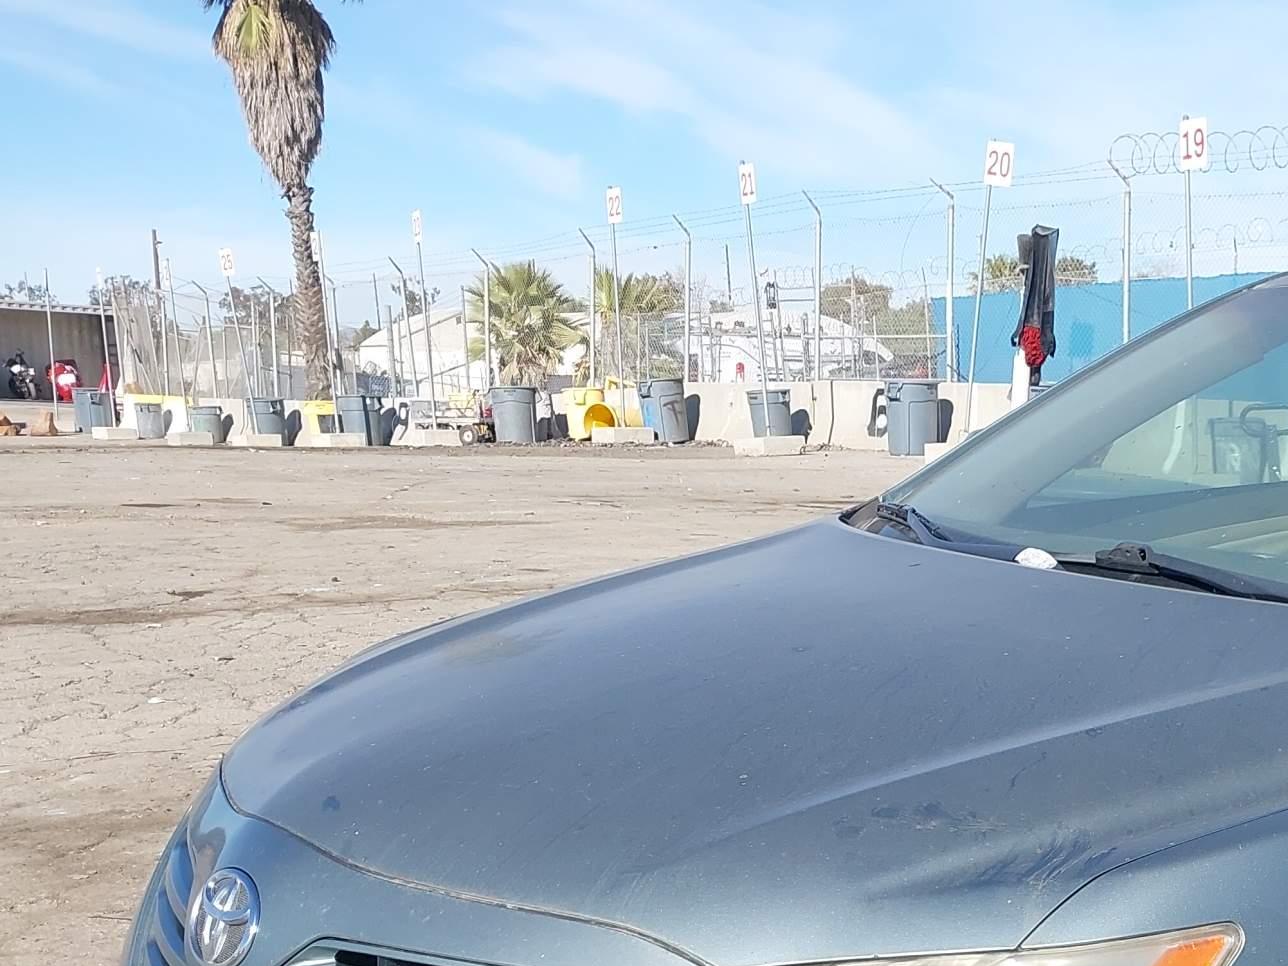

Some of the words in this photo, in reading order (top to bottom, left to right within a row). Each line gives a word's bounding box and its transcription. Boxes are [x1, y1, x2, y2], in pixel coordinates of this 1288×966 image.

[1182, 127, 1205, 160] 19
[987, 150, 1011, 178] 20
[741, 172, 755, 197] 21
[608, 195, 621, 217] 22
